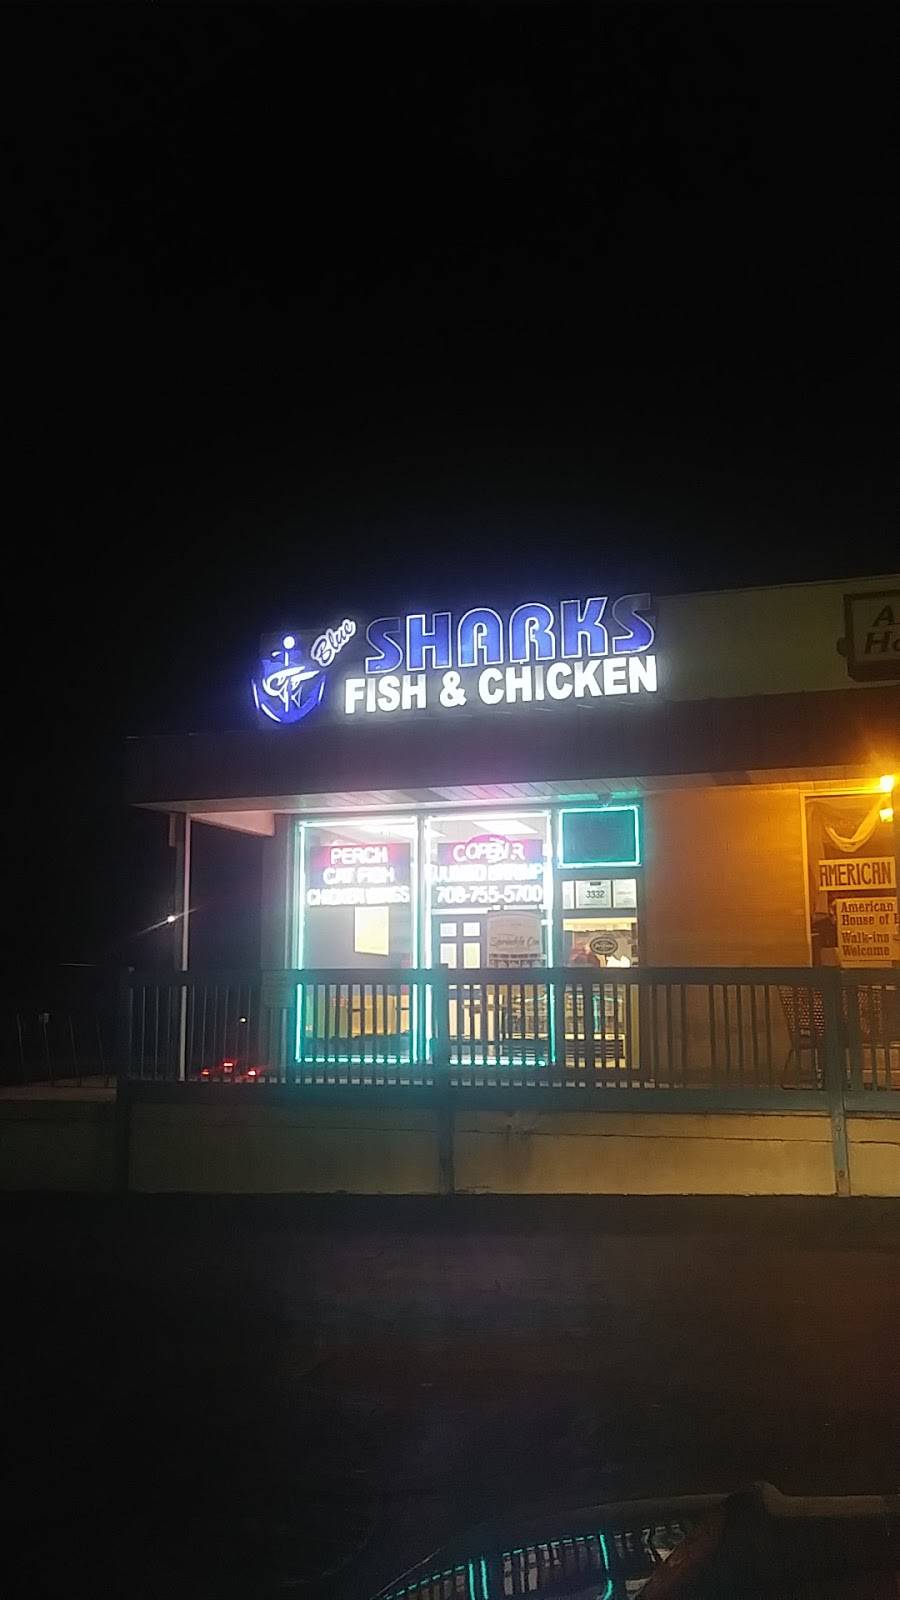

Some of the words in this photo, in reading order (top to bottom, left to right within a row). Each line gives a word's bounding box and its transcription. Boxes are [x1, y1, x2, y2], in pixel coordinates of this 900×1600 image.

[311, 618, 357, 667] Blue
[364, 594, 656, 676] SHARKS
[344, 673, 427, 714] FISH
[439, 670, 467, 707] &
[478, 654, 658, 706] CHICKEN
[330, 846, 389, 865] PERCH
[820, 862, 892, 887] AMERICAN
[436, 884, 543, 904] 708-755-5700
[586, 889, 606, 899] 3332
[841, 902, 894, 912] American
[842, 914, 875, 926] House
[879, 914, 889, 925] of
[842, 944, 890, 956] Welcome
